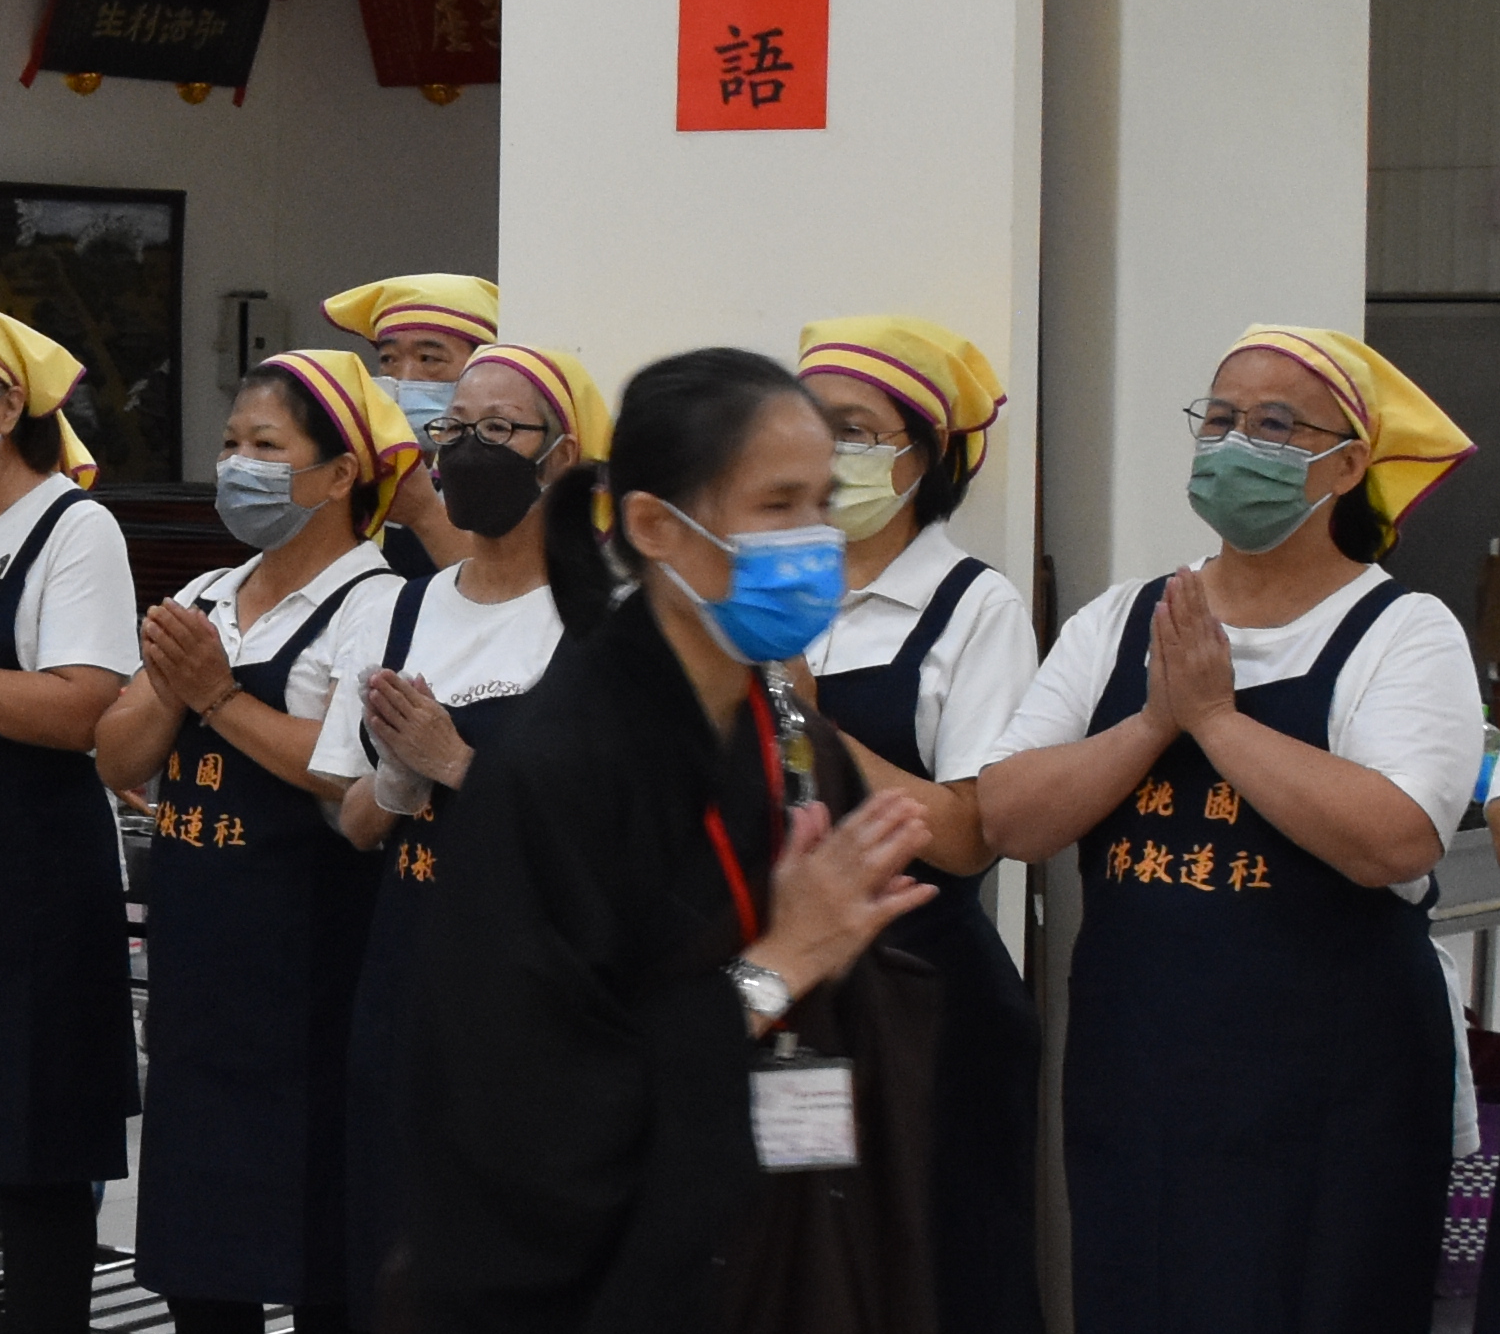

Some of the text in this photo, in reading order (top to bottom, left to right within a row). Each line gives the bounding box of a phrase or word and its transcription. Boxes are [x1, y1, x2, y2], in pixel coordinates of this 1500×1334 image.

[1136, 778, 1241, 826] 桃園
[1106, 837, 1272, 891] 佛教蓮社
